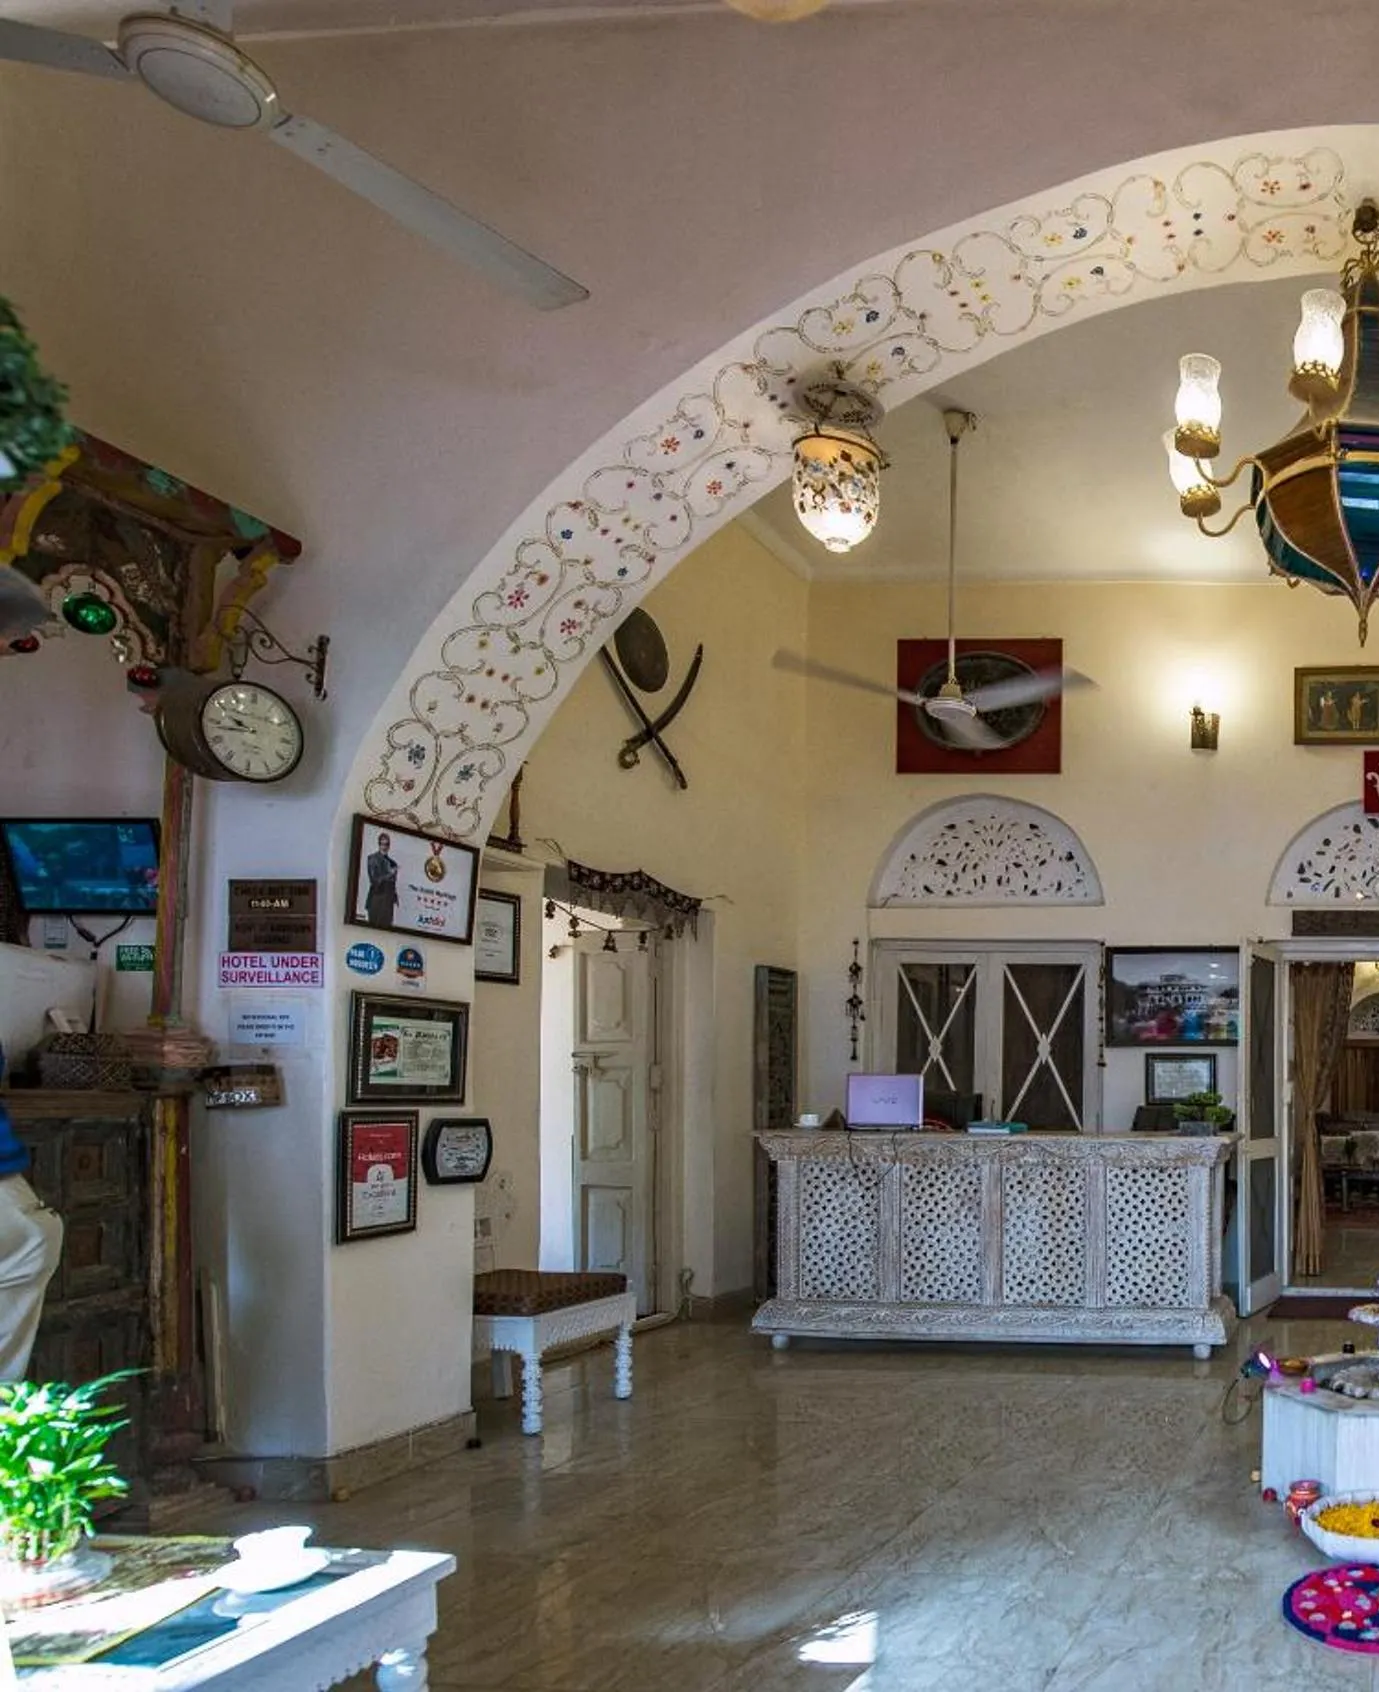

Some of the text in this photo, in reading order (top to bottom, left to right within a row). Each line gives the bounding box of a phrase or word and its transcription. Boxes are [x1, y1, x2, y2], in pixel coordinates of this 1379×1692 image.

[221, 956, 319, 968] HOTEL UNDER
[221, 971, 319, 983] SURVEILLANCE
